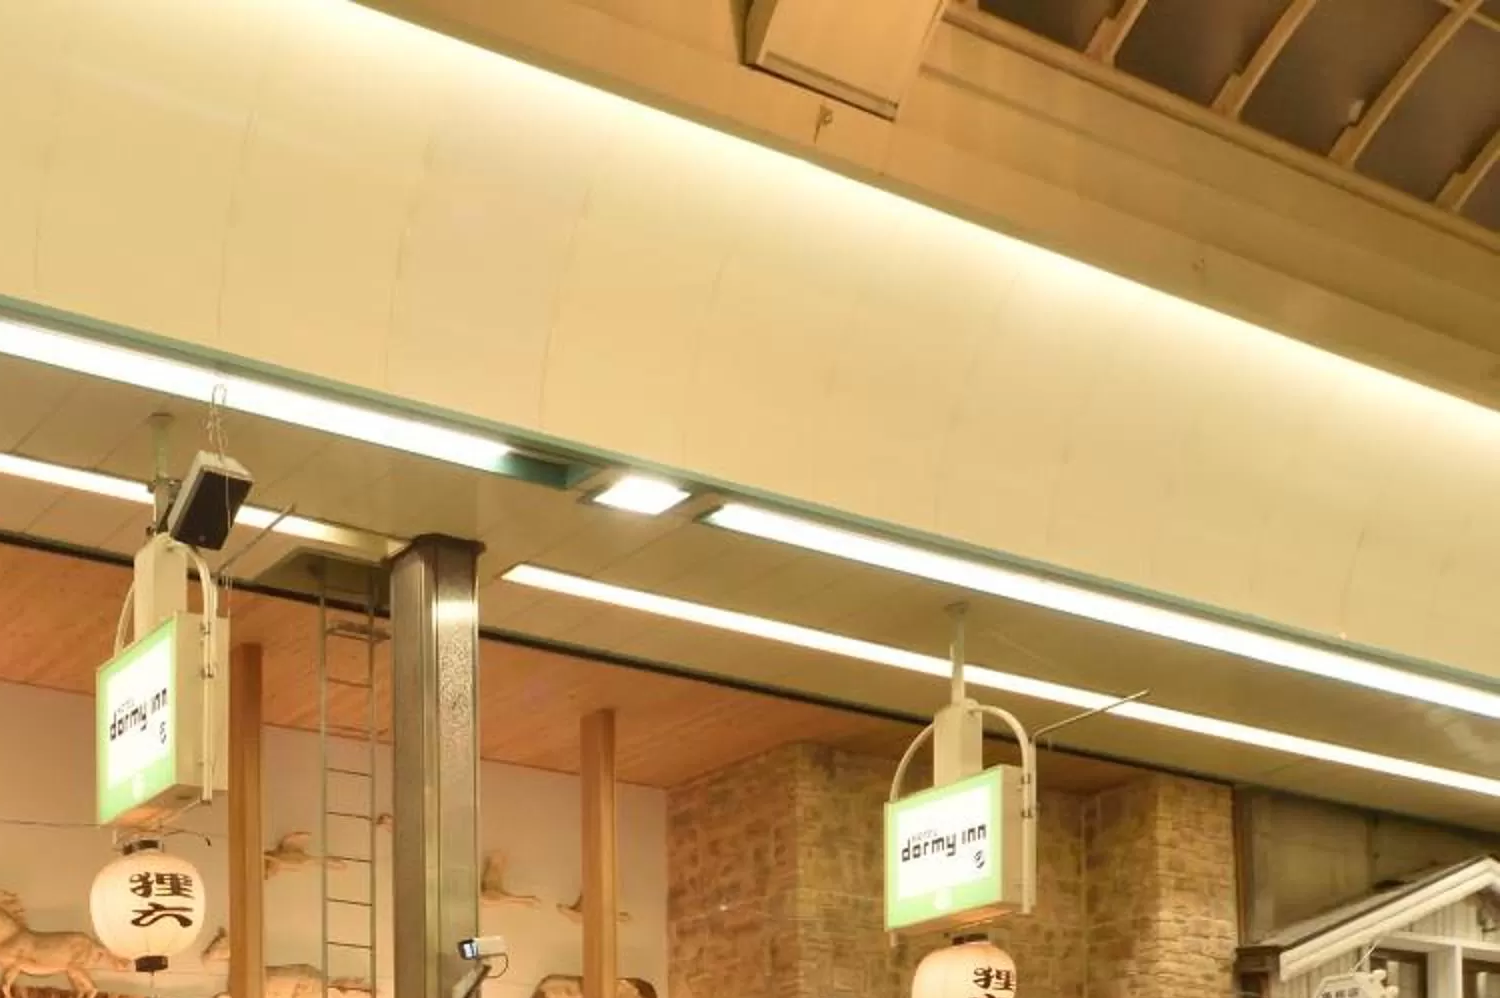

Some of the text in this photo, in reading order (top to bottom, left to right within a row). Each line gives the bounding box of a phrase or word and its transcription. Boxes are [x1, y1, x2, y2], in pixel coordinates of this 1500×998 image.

[109, 700, 148, 742] dormy
[901, 832, 957, 863] dormy
[961, 823, 987, 845] inn
